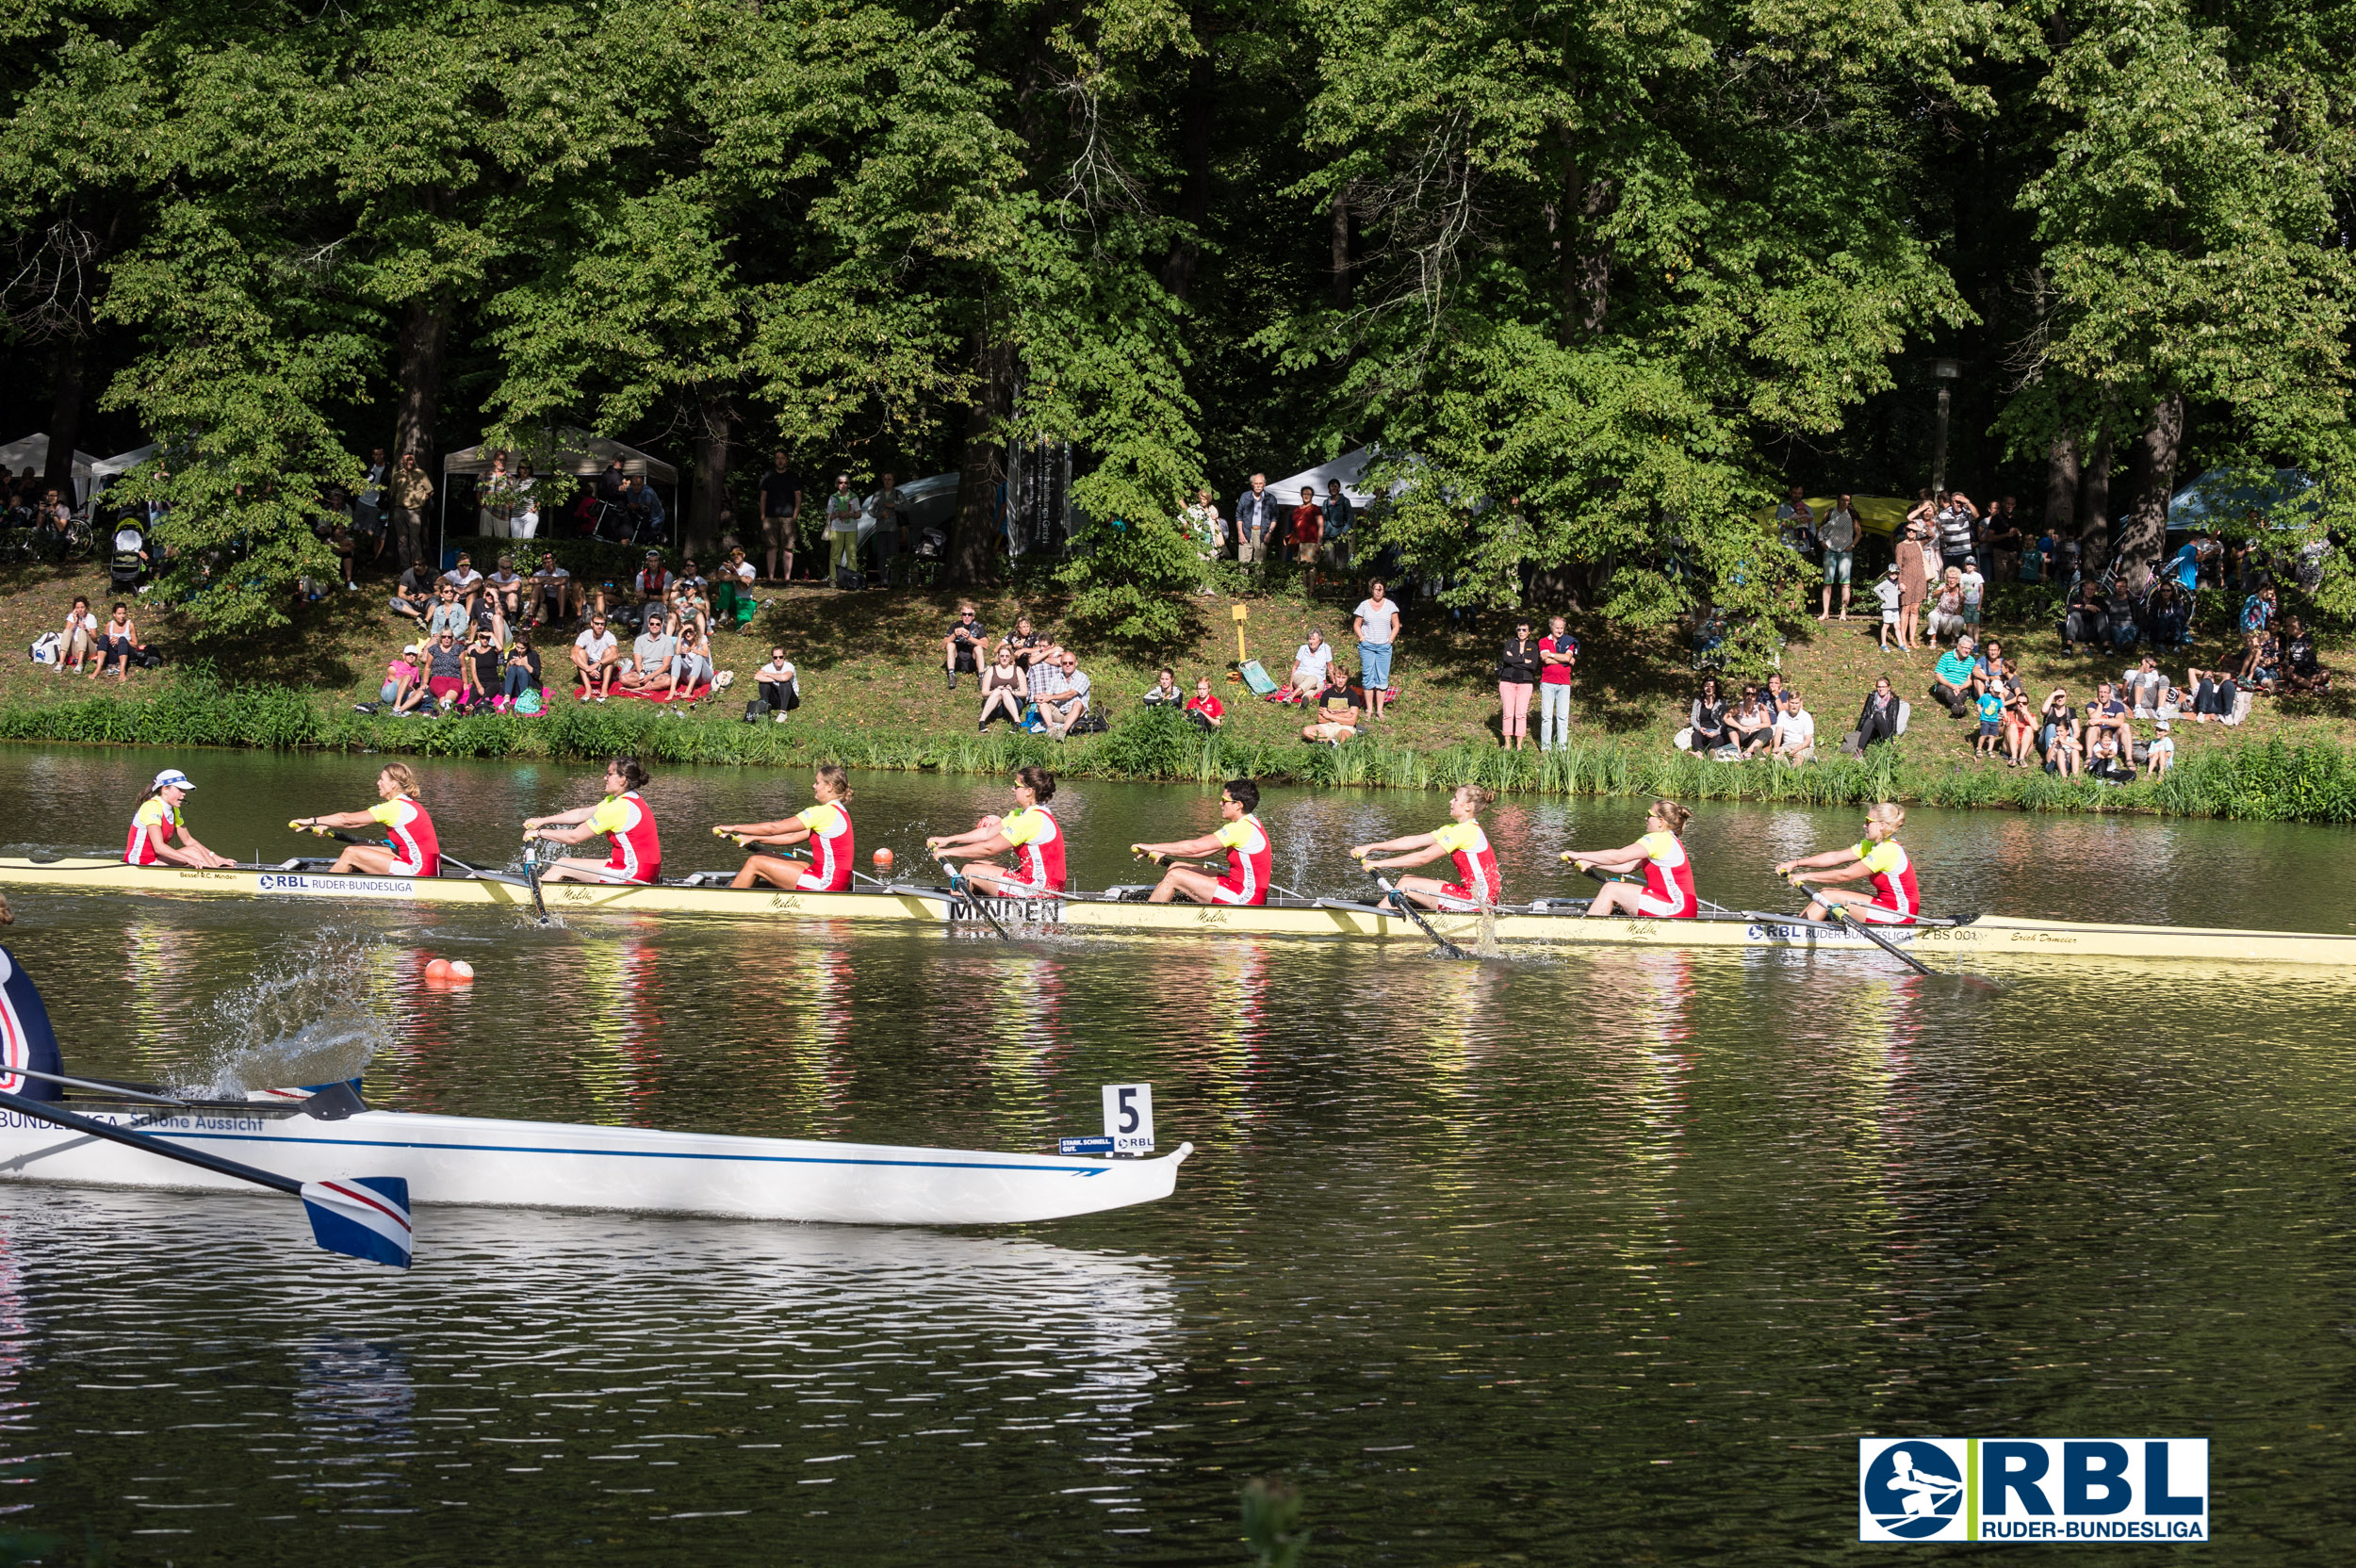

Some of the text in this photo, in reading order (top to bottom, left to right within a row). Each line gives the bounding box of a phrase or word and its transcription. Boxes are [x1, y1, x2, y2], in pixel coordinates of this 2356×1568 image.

[1042, 464, 1052, 519] Veranstaltungs
[1041, 520, 1051, 544] GmbH
[276, 875, 413, 892] RBL RUDER-BUNDESLIGA
[1766, 925, 1801, 938] RBL
[1922, 930, 1930, 939] Z
[1934, 930, 1950, 940] BS
[1119, 1087, 1139, 1134] 5
[130, 1112, 189, 1129] Schöne
[195, 1115, 264, 1132] Aussicht
[1130, 1137, 1154, 1147] RBL
